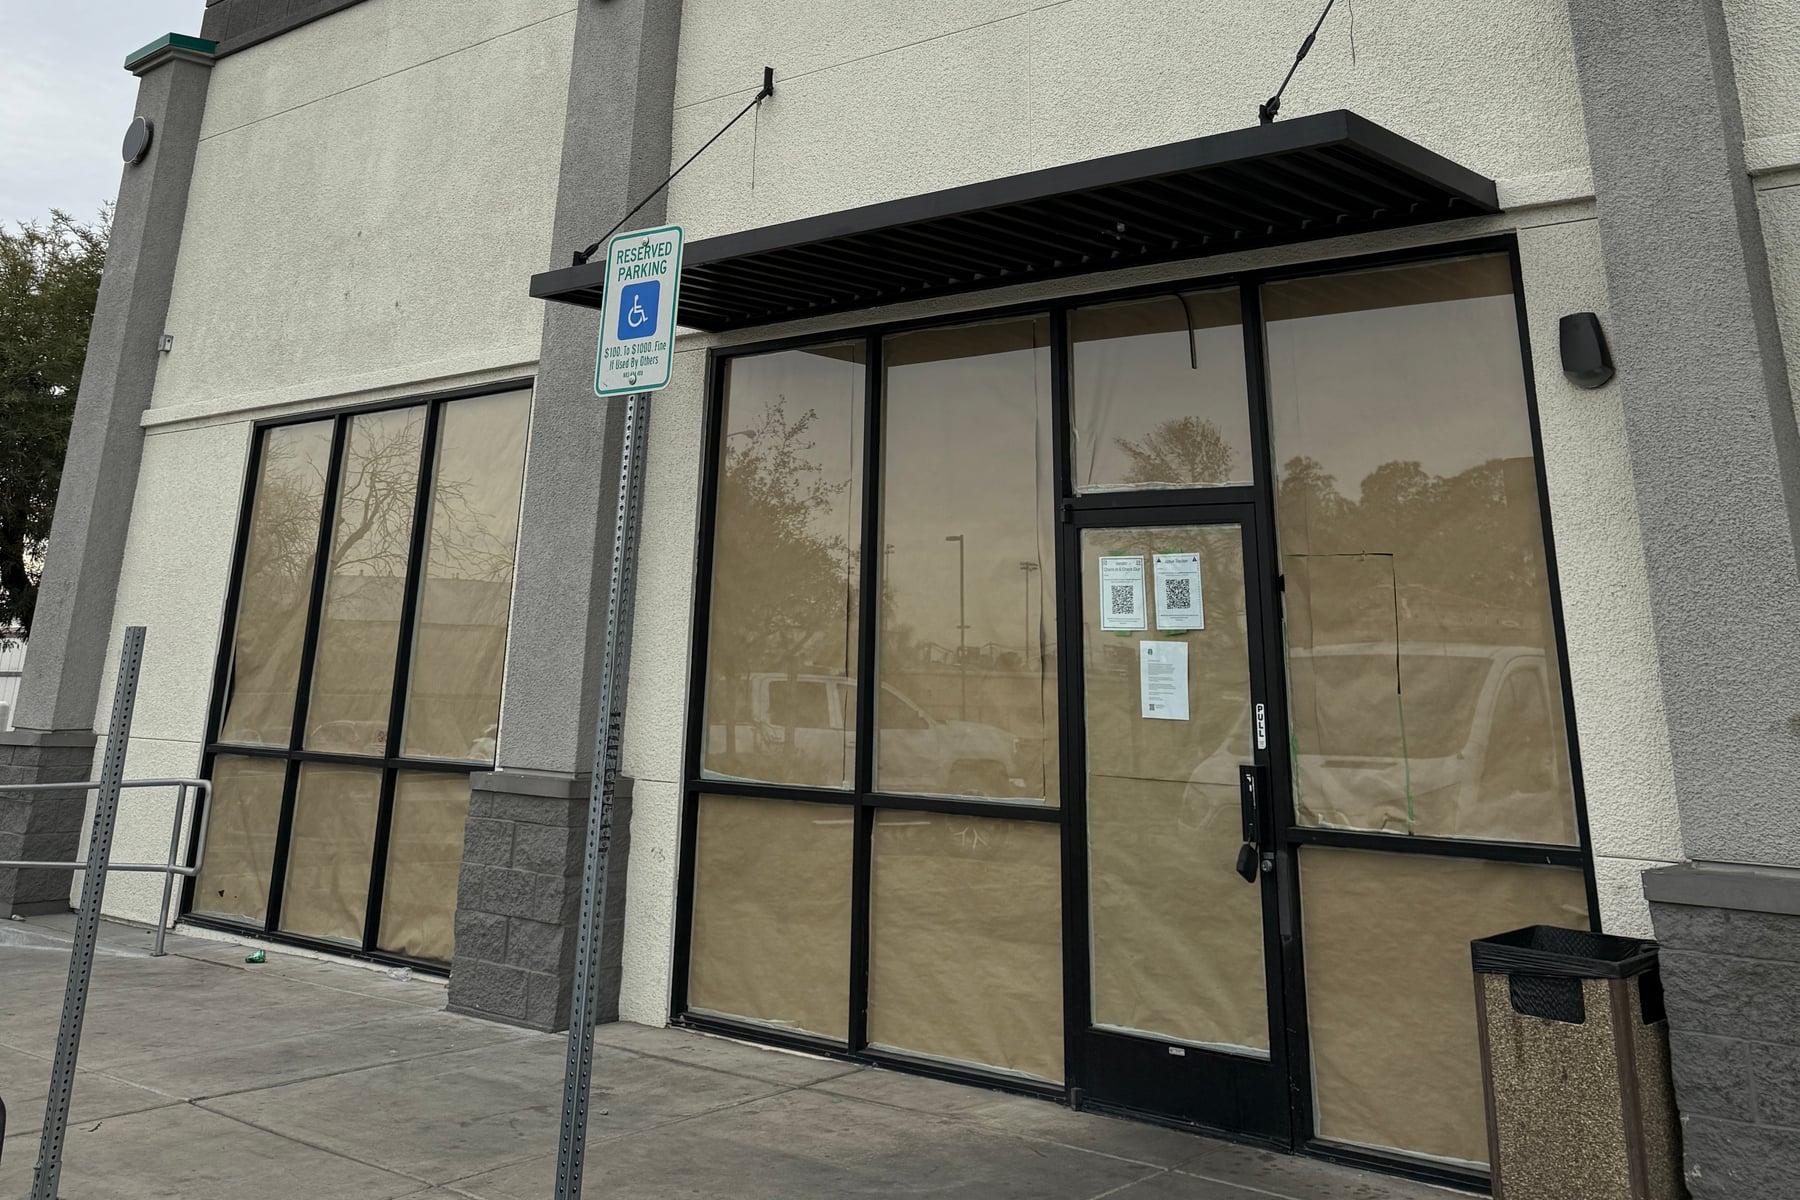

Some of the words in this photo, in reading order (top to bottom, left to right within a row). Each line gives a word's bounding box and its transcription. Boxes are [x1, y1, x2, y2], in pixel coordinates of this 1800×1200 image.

[616, 241, 672, 265] RESERVED
[618, 260, 667, 282] PARKING
[604, 346, 622, 359] $100.
[624, 345, 630, 356] To
[631, 341, 654, 355] $1000.
[654, 340, 667, 352] Fine
[609, 360, 614, 371] If
[615, 358, 630, 370] Used
[630, 357, 639, 370] By
[639, 355, 659, 367] Others
[1257, 705, 1265, 738] PULL
